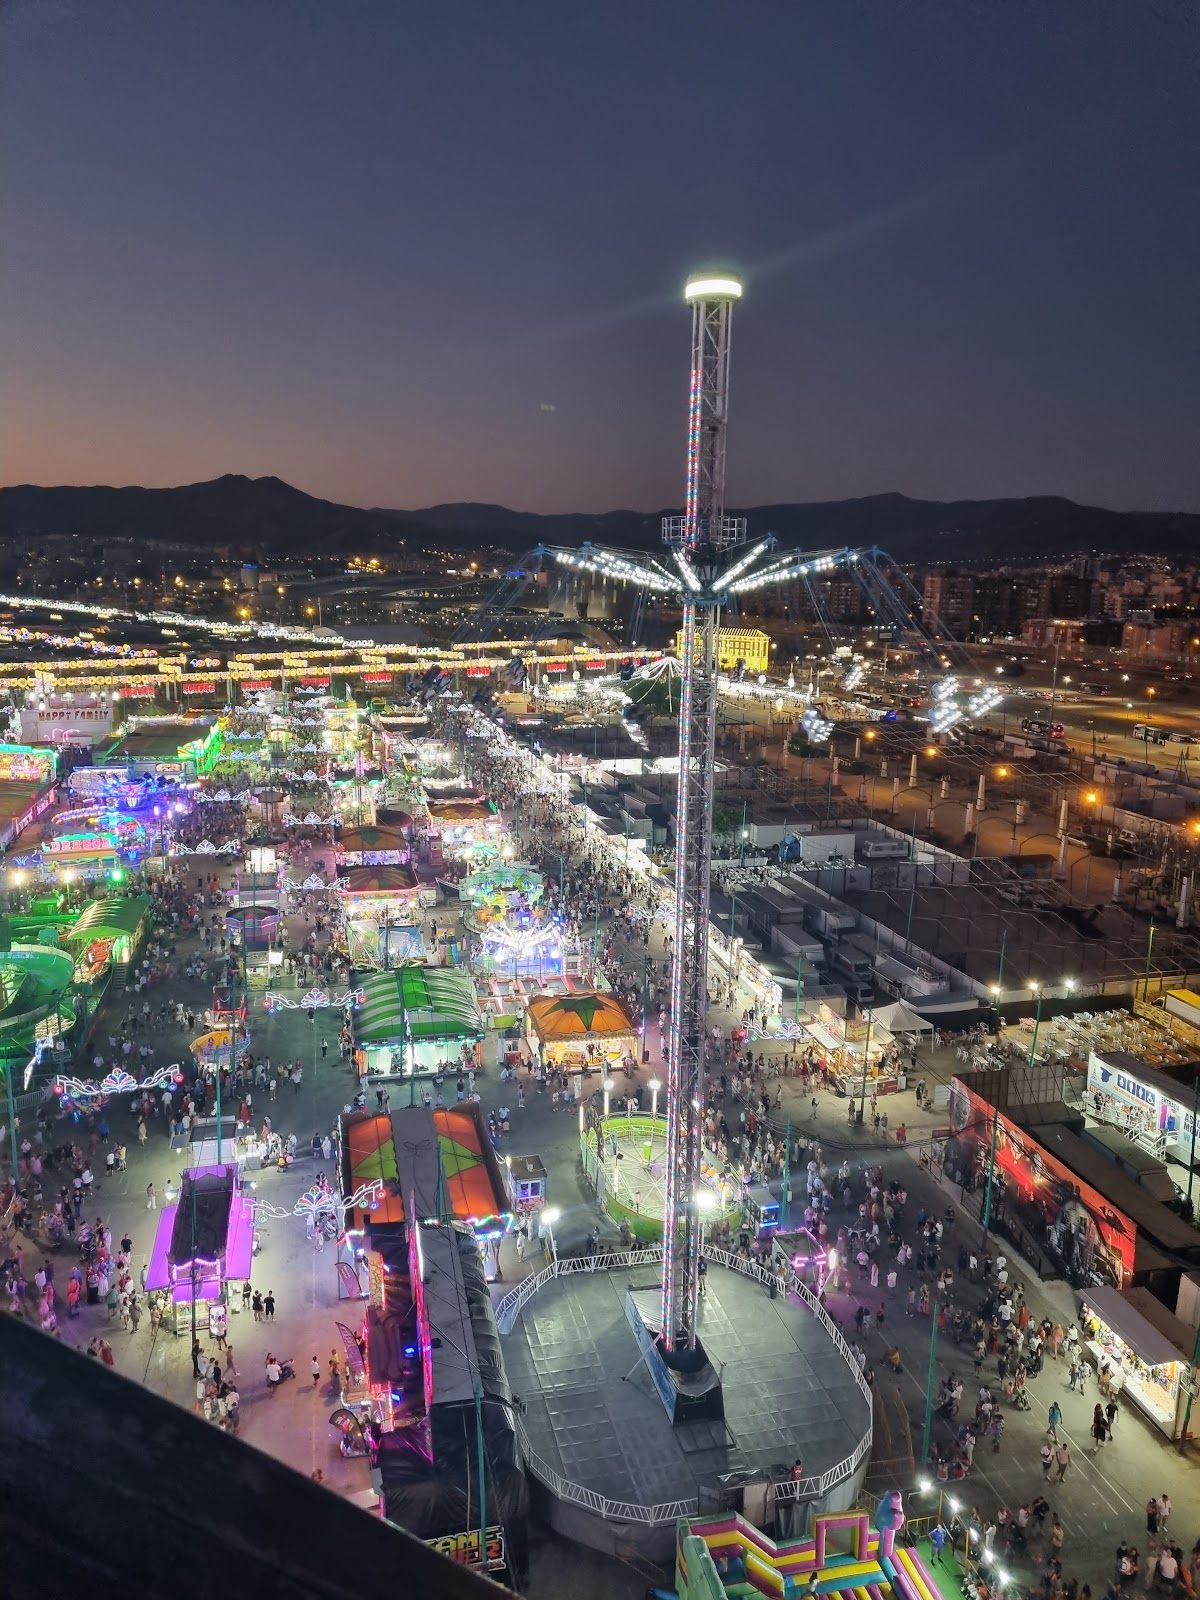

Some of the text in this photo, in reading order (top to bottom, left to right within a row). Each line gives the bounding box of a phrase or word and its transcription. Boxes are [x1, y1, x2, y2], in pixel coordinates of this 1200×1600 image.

[38, 710, 109, 721] HAPPY FAMILY
[424, 1526, 502, 1553] AME
